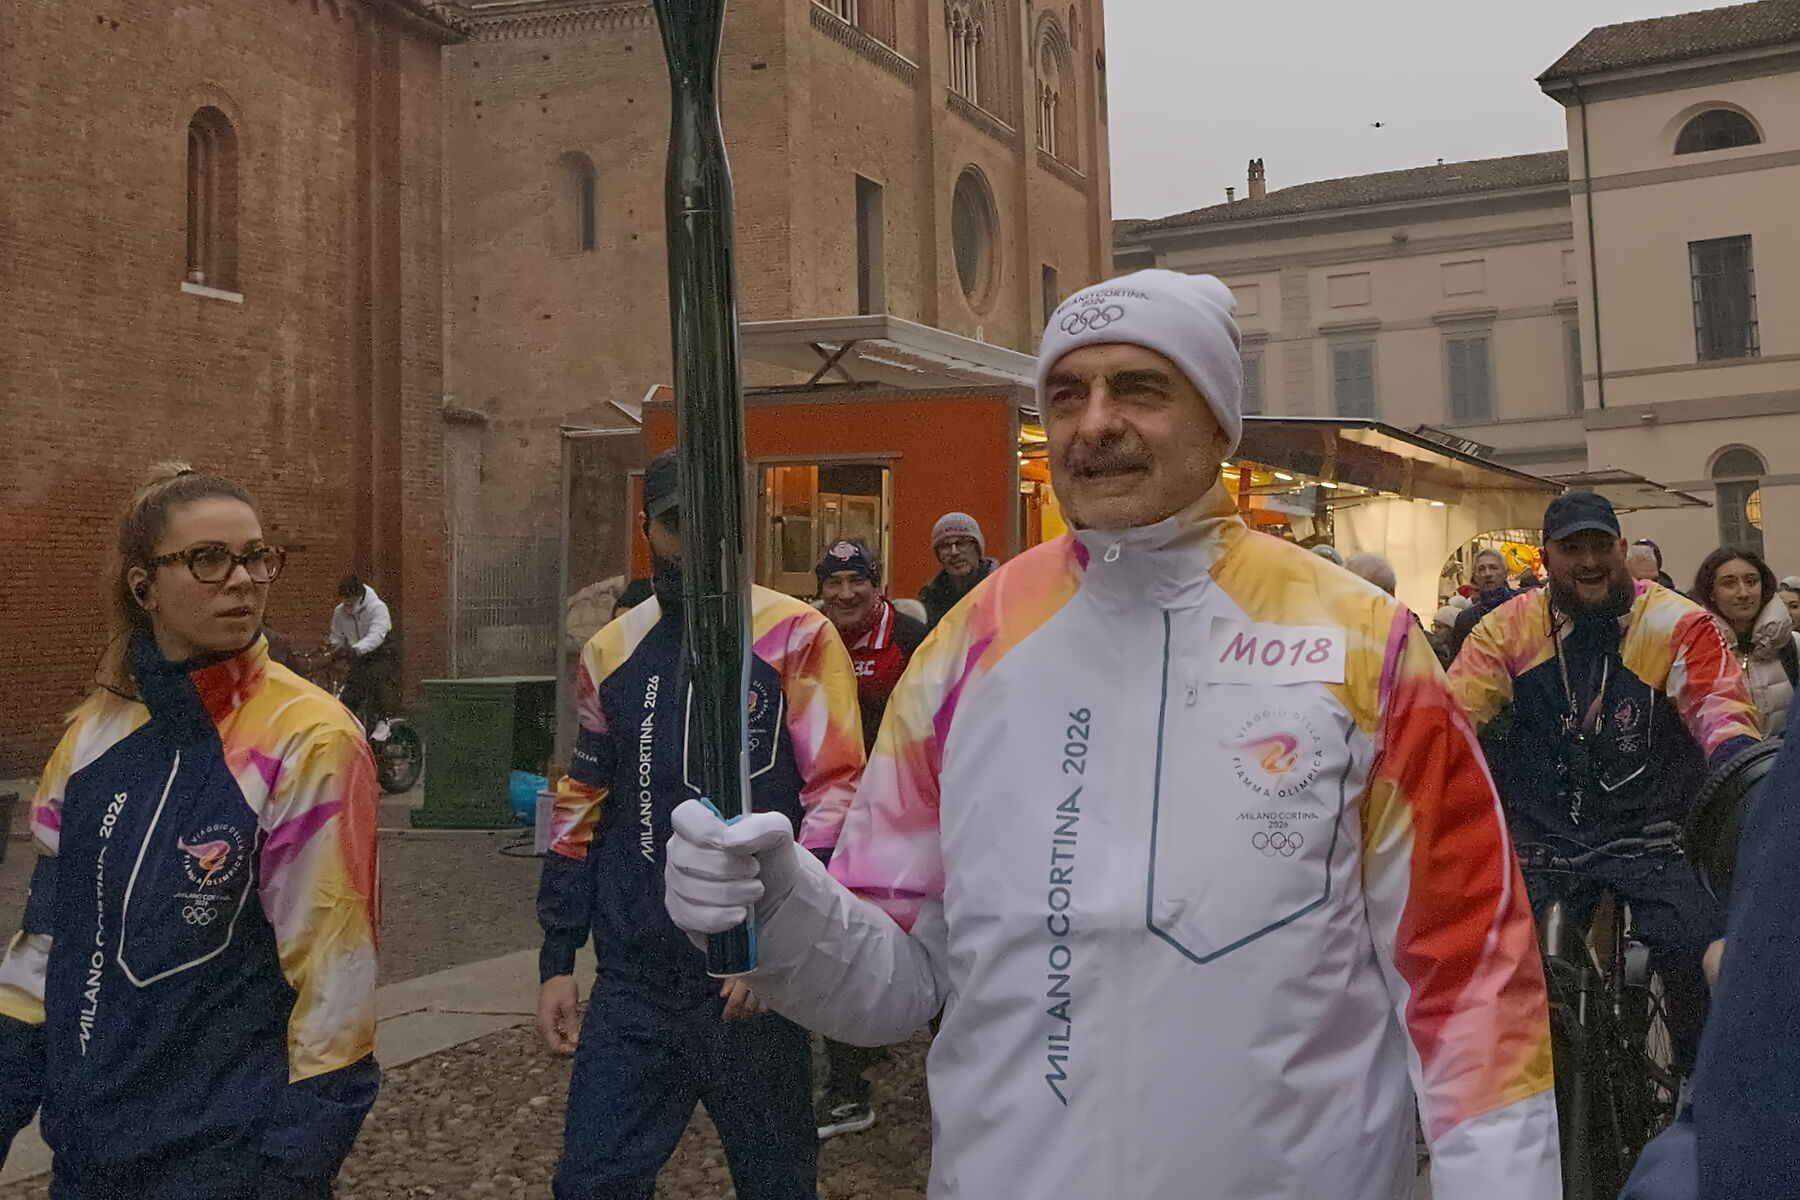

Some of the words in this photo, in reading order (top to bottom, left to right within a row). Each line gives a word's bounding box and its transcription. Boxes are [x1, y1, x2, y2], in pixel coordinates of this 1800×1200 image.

[1094, 288, 1150, 301] CORTINA
[1218, 632, 1333, 667] M018
[643, 675, 660, 709] 2026
[1062, 707, 1092, 776] 2026
[1236, 709, 1287, 740] VIAGGIO
[1292, 712, 1321, 743] DELLA
[639, 711, 655, 787] CORTINA
[1232, 756, 1271, 797] FIAMMA
[1278, 750, 1323, 798] OLIMPICA
[639, 790, 655, 863] MILANO
[1235, 811, 1278, 821] MILANO
[1279, 811, 1319, 820] CORTINA
[1268, 820, 1289, 829] 2026
[1046, 785, 1084, 938] CORTINA
[79, 951, 105, 1057] MILANO
[99, 791, 128, 839] 2026
[1045, 945, 1073, 1107] MILANO
